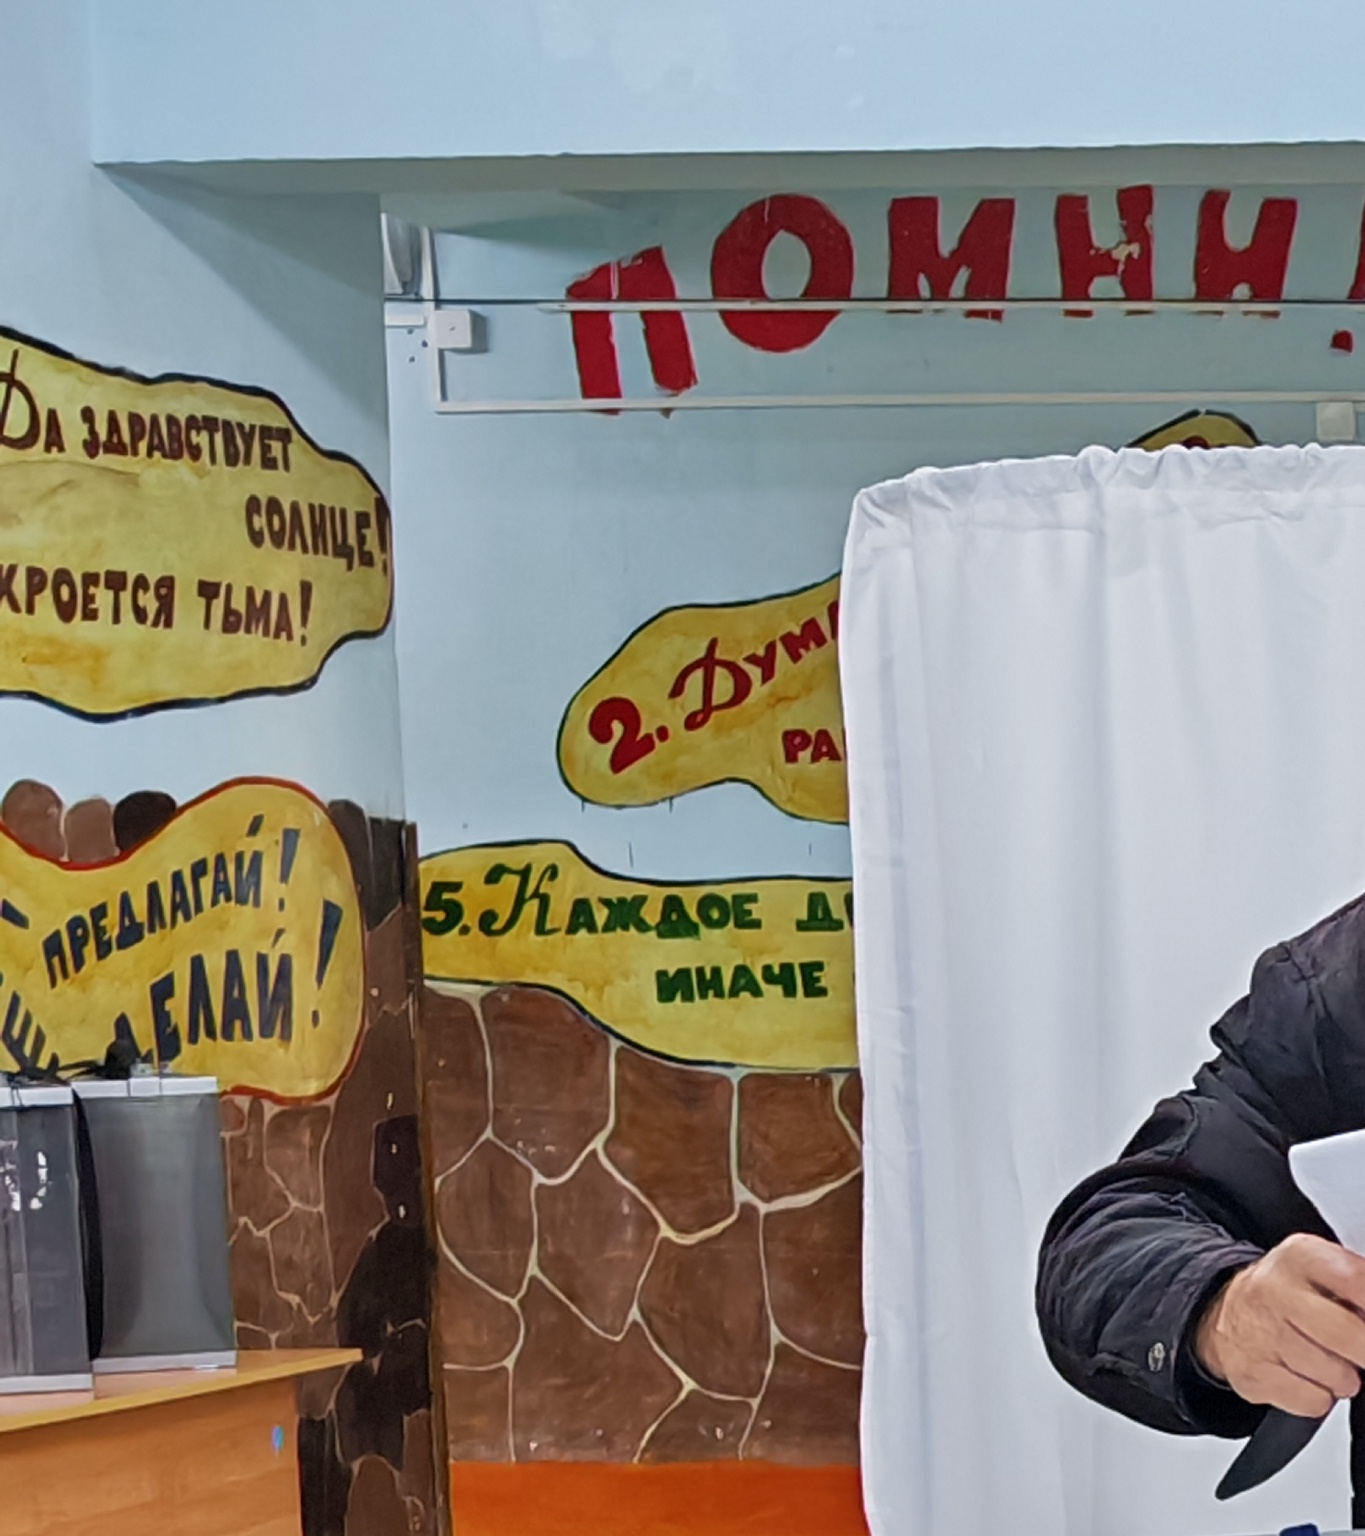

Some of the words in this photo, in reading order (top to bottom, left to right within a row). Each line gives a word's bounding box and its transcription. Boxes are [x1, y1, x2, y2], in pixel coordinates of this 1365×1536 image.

[80, 405, 293, 473] ЗДРАВСТВУЕТ
[245, 494, 390, 578] СОЛНЦЕ!
[198, 579, 313, 647] ТЬМА!
[655, 961, 829, 1004] ИНАЧЕ
